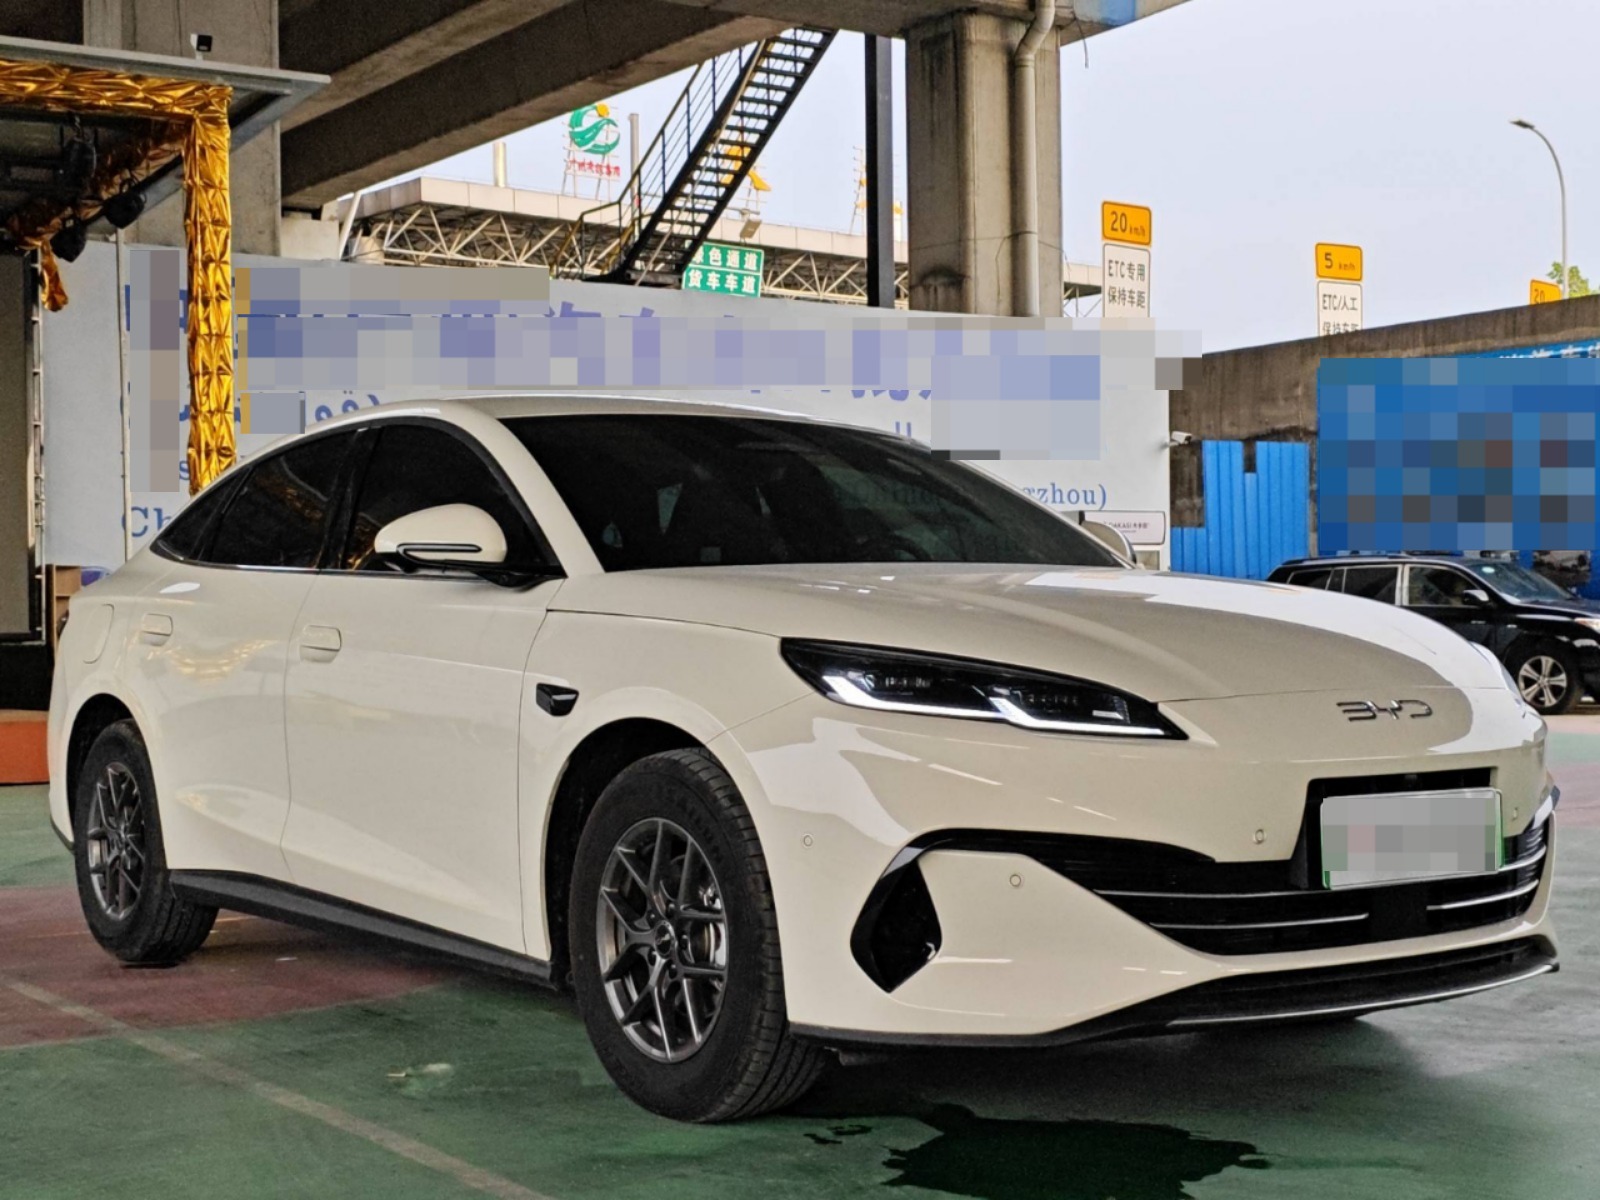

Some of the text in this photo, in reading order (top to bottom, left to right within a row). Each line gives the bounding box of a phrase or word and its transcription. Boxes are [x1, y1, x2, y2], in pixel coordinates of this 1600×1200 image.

[1110, 210, 1127, 233] 20
[1108, 259, 1146, 282] ETC专用
[1324, 252, 1333, 269] 5
[688, 269, 756, 294] 货车车道
[1108, 286, 1146, 309] 保持车距
[1322, 293, 1358, 311] ETC/人工
[1534, 288, 1545, 305] 20
[1336, 699, 1433, 722] BYD
